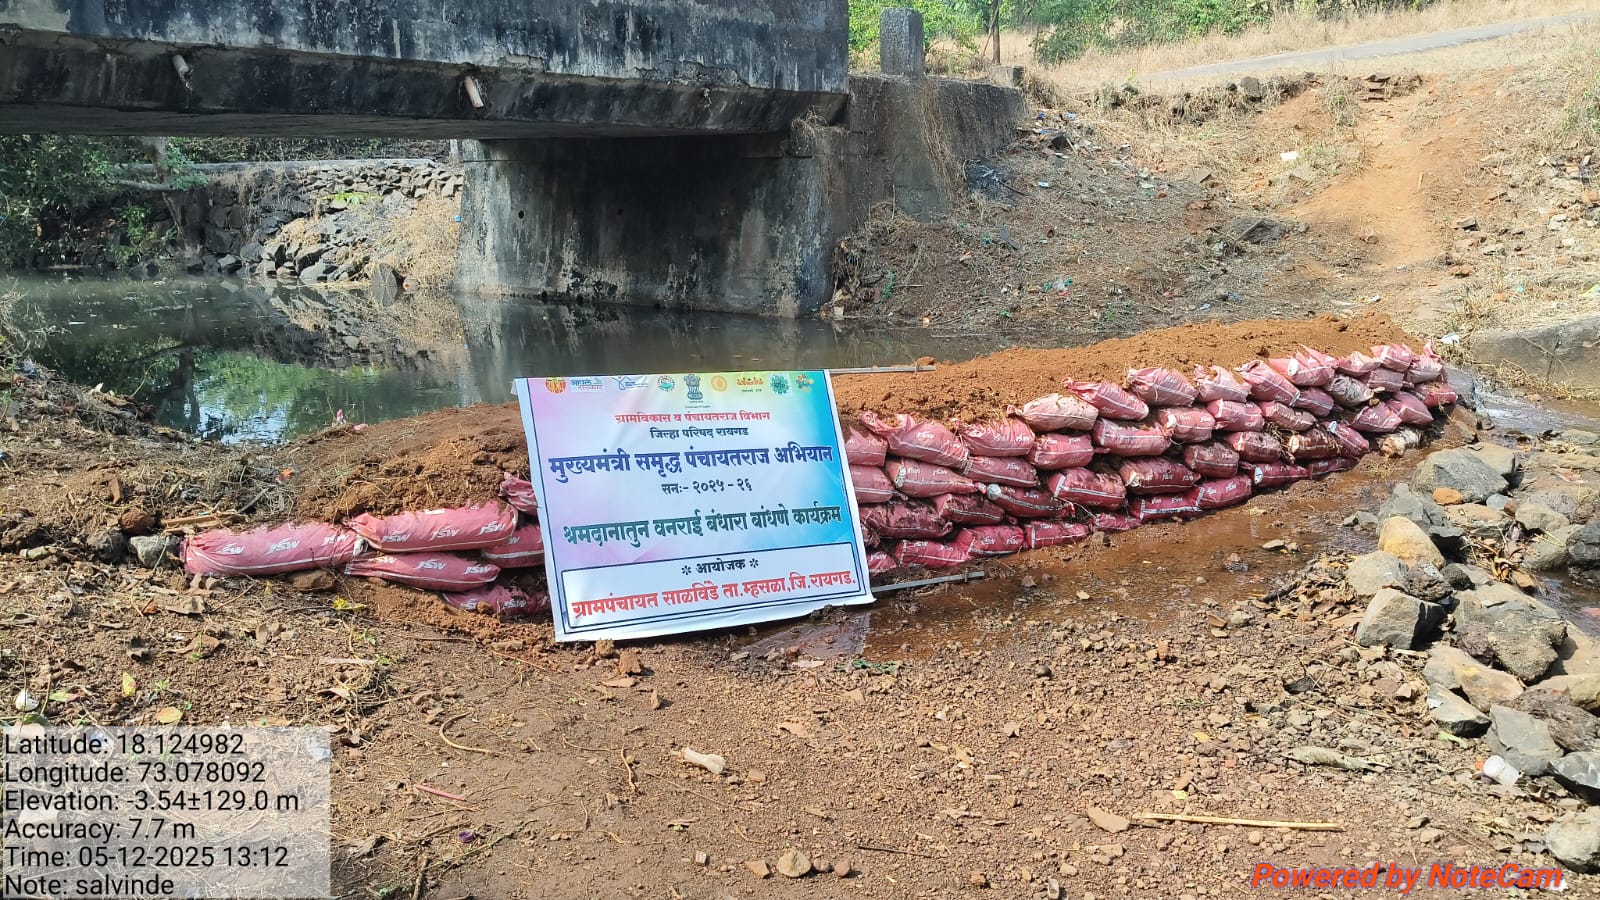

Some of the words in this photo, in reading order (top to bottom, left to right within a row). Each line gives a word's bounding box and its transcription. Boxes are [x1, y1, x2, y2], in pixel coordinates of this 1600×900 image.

[614, 411, 671, 424] ग्रामविकास
[674, 413, 682, 422] व
[684, 410, 737, 422] पंचायतराज
[739, 409, 770, 420] विभाग
[649, 426, 679, 439] जिल्हा
[682, 426, 714, 438] परिषद
[716, 427, 749, 436] रायगड
[548, 447, 631, 484] मुख्यमंत्री
[634, 452, 683, 478] समृद्ध
[684, 445, 770, 467] पंचायतराज
[774, 441, 833, 463] अभियान
[692, 479, 724, 494] २०२५
[737, 478, 752, 491] २६
[479, 521, 506, 536] JSW
[563, 520, 649, 547] श्रमदानातुन
[653, 509, 703, 536] वनराई
[705, 508, 748, 532] बंधारा
[750, 503, 789, 528] बांधणे
[792, 501, 841, 525] कार्यक्रम
[381, 530, 410, 543] JSW
[431, 524, 460, 540] JSW
[415, 559, 446, 570] JSW
[464, 563, 490, 575] JSW
[696, 558, 745, 573] आयोजक
[572, 592, 658, 619] ग्रामपंचायत
